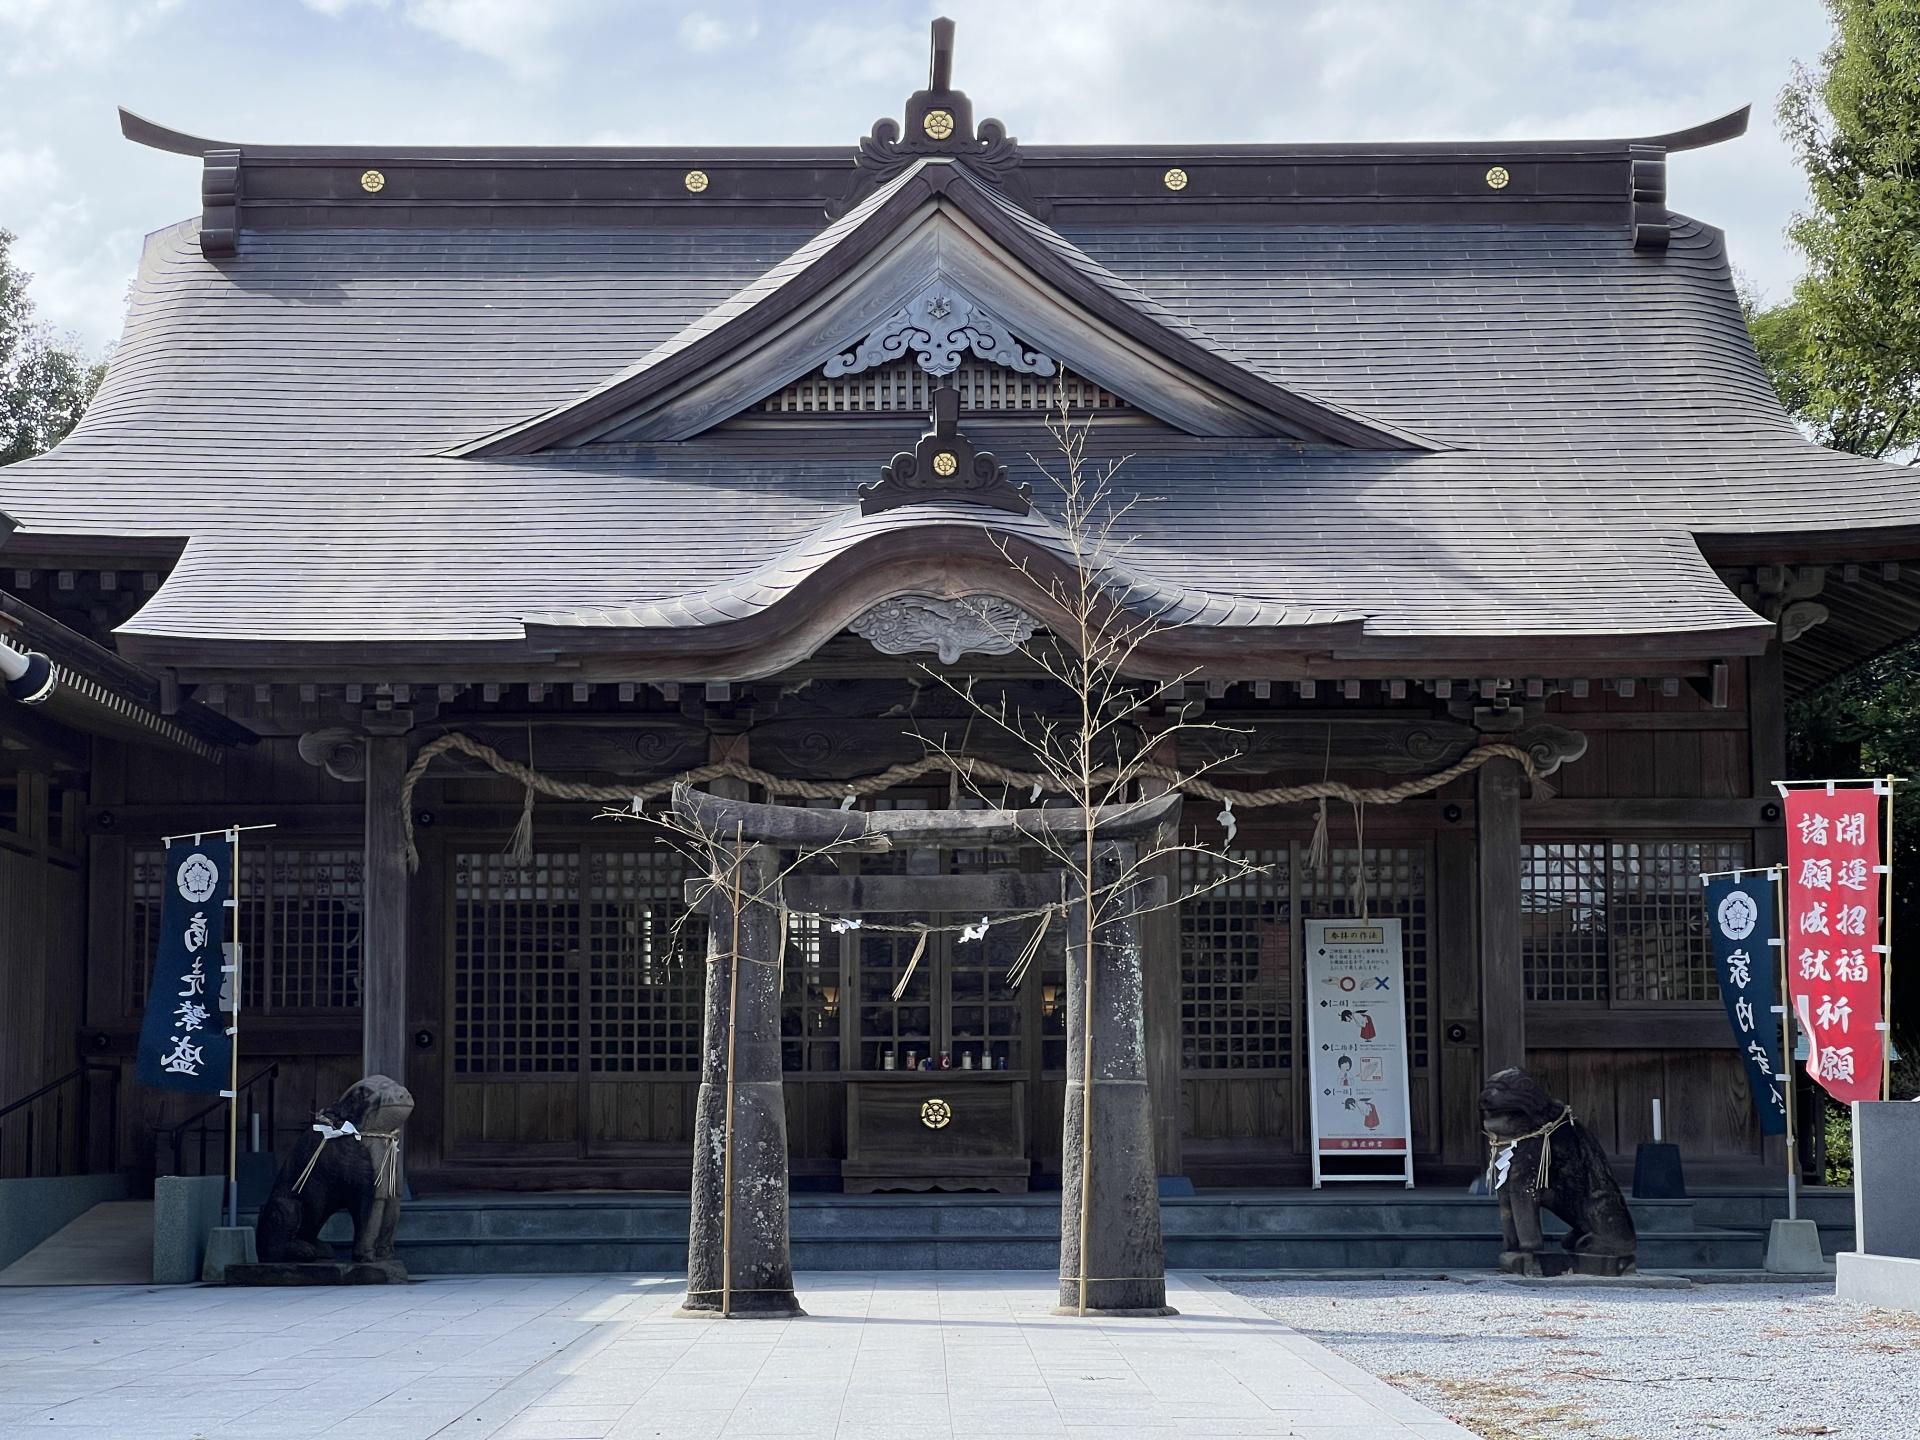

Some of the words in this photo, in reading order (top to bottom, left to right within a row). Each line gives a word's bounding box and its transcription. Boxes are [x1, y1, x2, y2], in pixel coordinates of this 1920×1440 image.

[1796, 813, 1832, 982] 諸願成就
[1835, 812, 1868, 982] 開運招福
[1815, 994, 1855, 1084] 祈願
